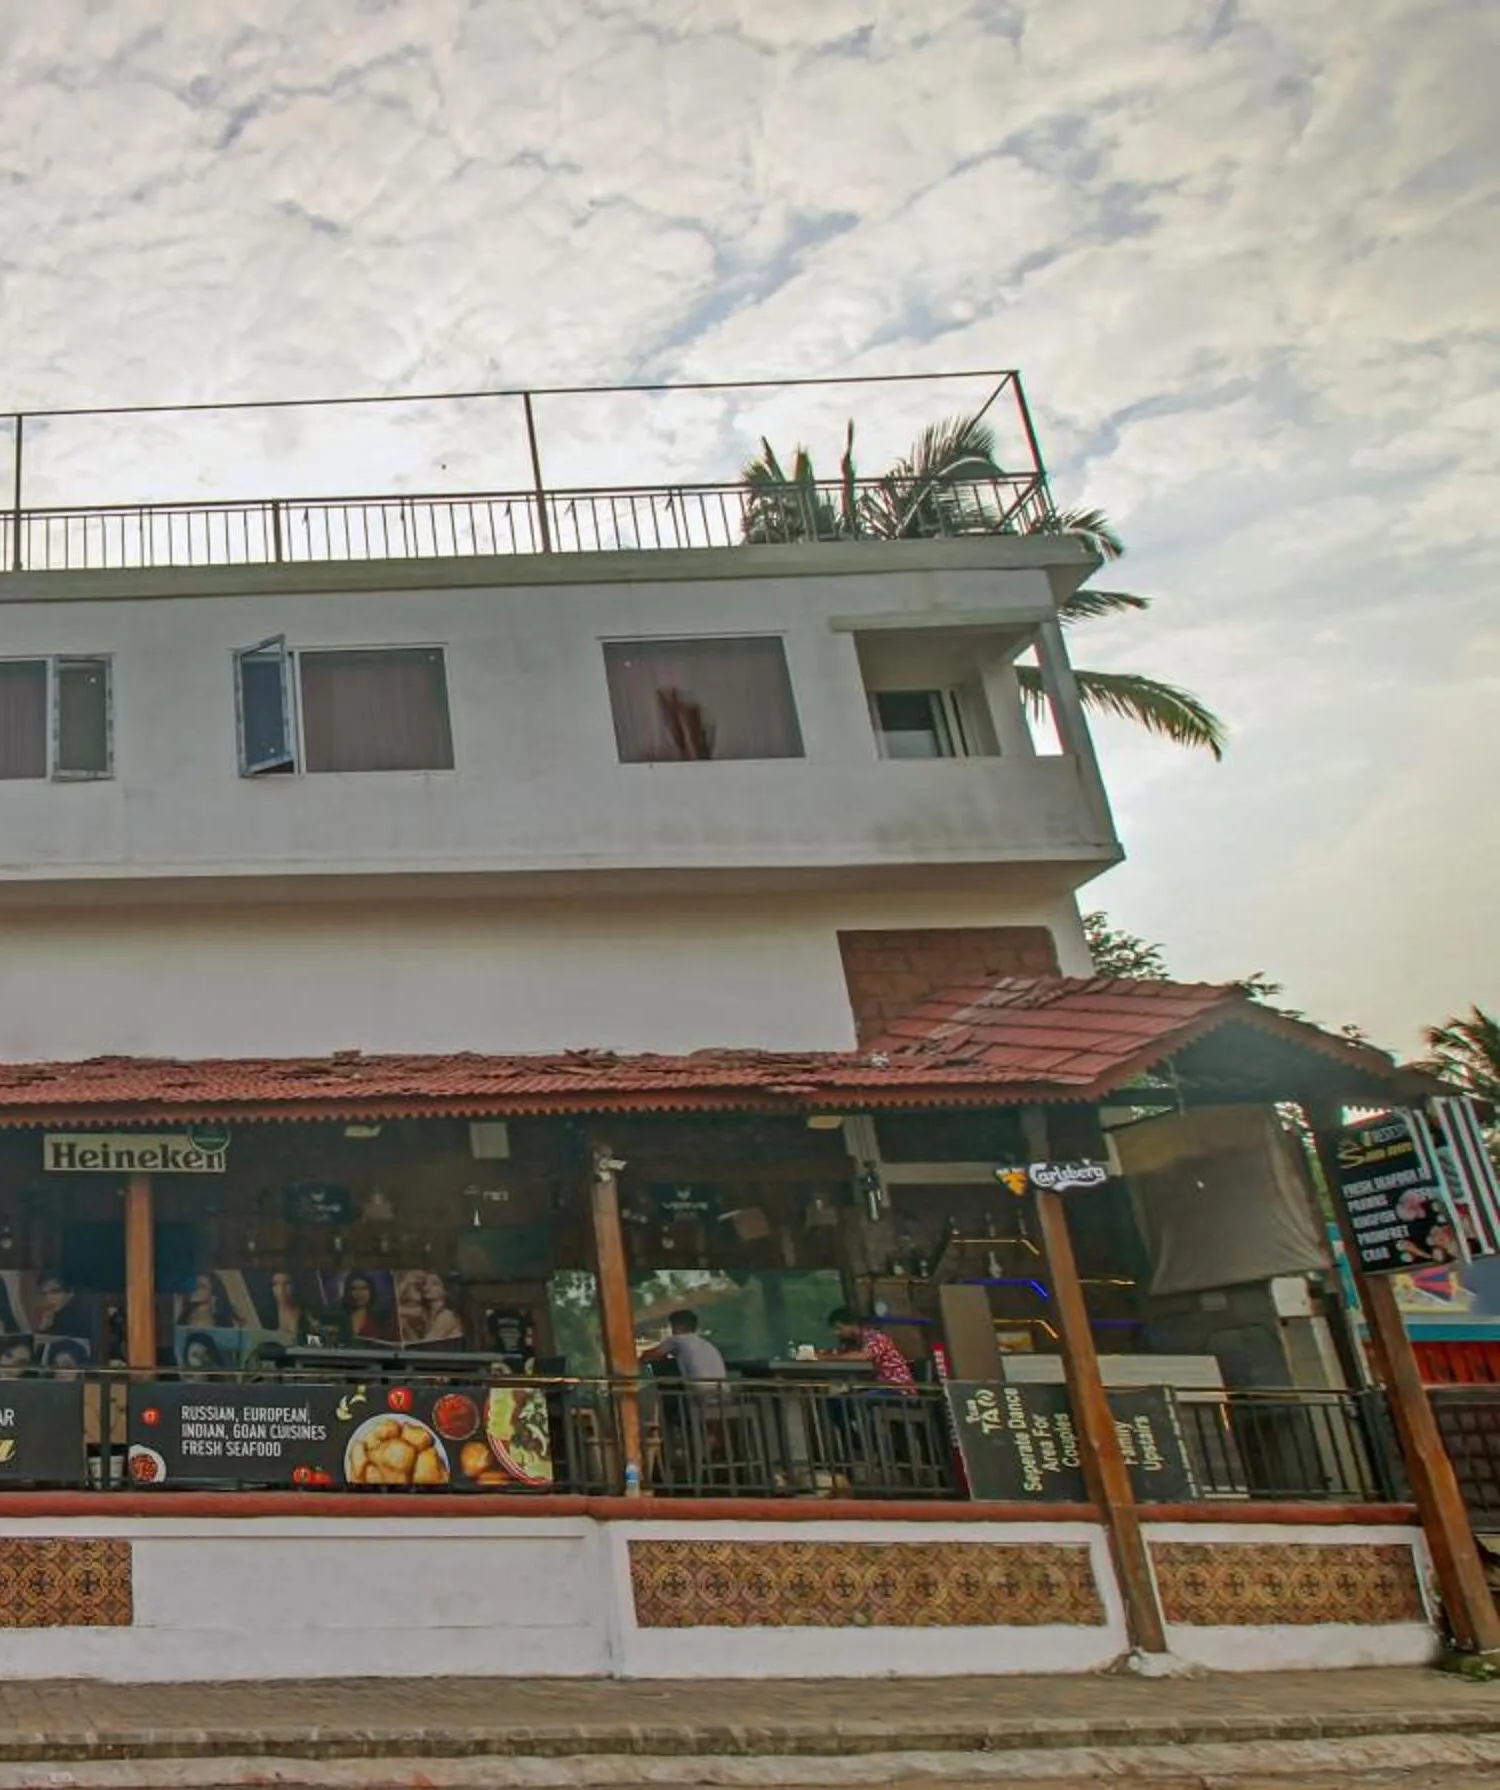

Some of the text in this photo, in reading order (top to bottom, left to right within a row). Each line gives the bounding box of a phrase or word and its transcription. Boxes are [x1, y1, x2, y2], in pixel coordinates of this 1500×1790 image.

[51, 1141, 223, 1169] Heineken
[1029, 1161, 1106, 1191] Carlsberg
[181, 1405, 311, 1423] RUSSIAN, EUROPEAN,
[975, 1389, 1000, 1434] TAO
[1003, 1387, 1025, 1429] Dance
[181, 1423, 326, 1440] INDIAN, GOAN CUISINES
[181, 1439, 282, 1457] FRESH SEAFOOD
[1033, 1413, 1061, 1473] Area For
[1054, 1412, 1080, 1467] Couples
[1134, 1414, 1164, 1471] Upstairs
